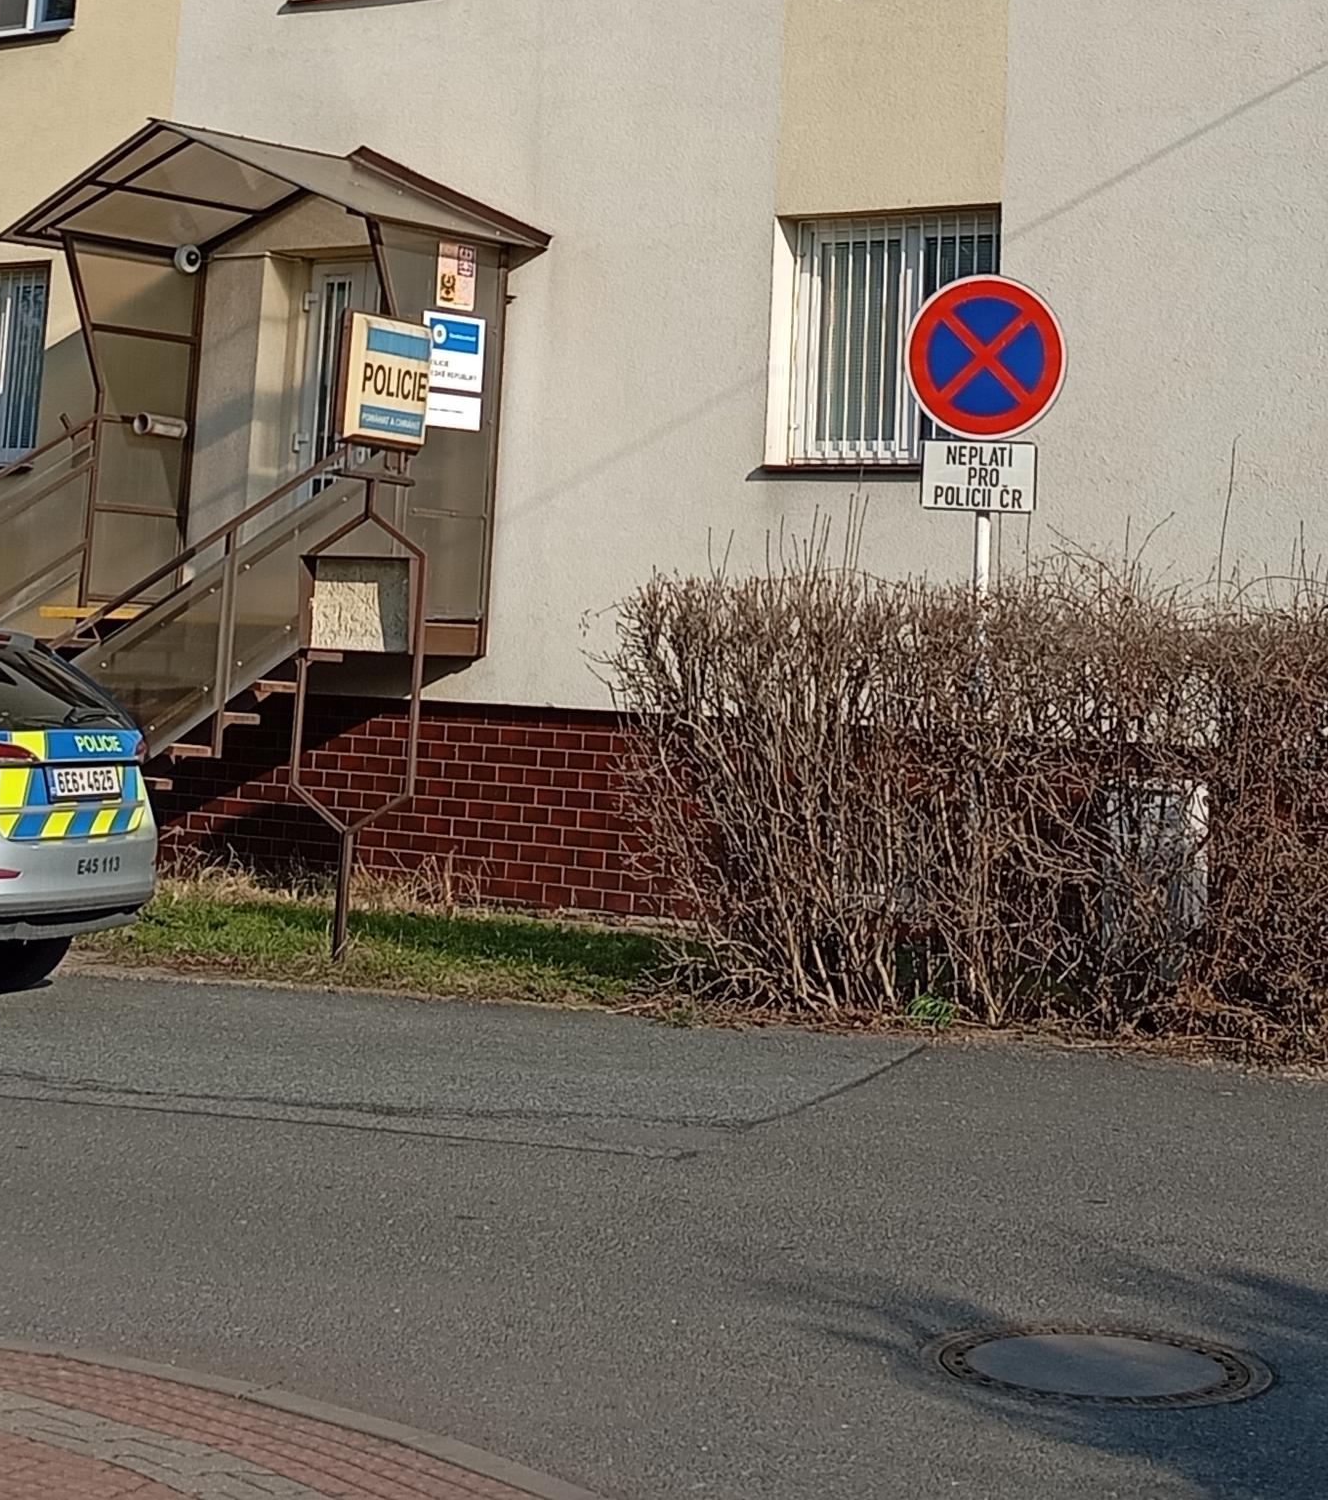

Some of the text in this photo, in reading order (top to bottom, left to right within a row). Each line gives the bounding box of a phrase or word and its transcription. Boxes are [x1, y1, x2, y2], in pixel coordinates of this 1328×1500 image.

[362, 362, 428, 401] POLICIE
[946, 444, 1013, 467] NEPLATÍ
[967, 467, 1000, 488] PRO
[934, 483, 1023, 509] POLICII ČR
[74, 735, 123, 753] POLICIE
[77, 856, 121, 875] E45 113
